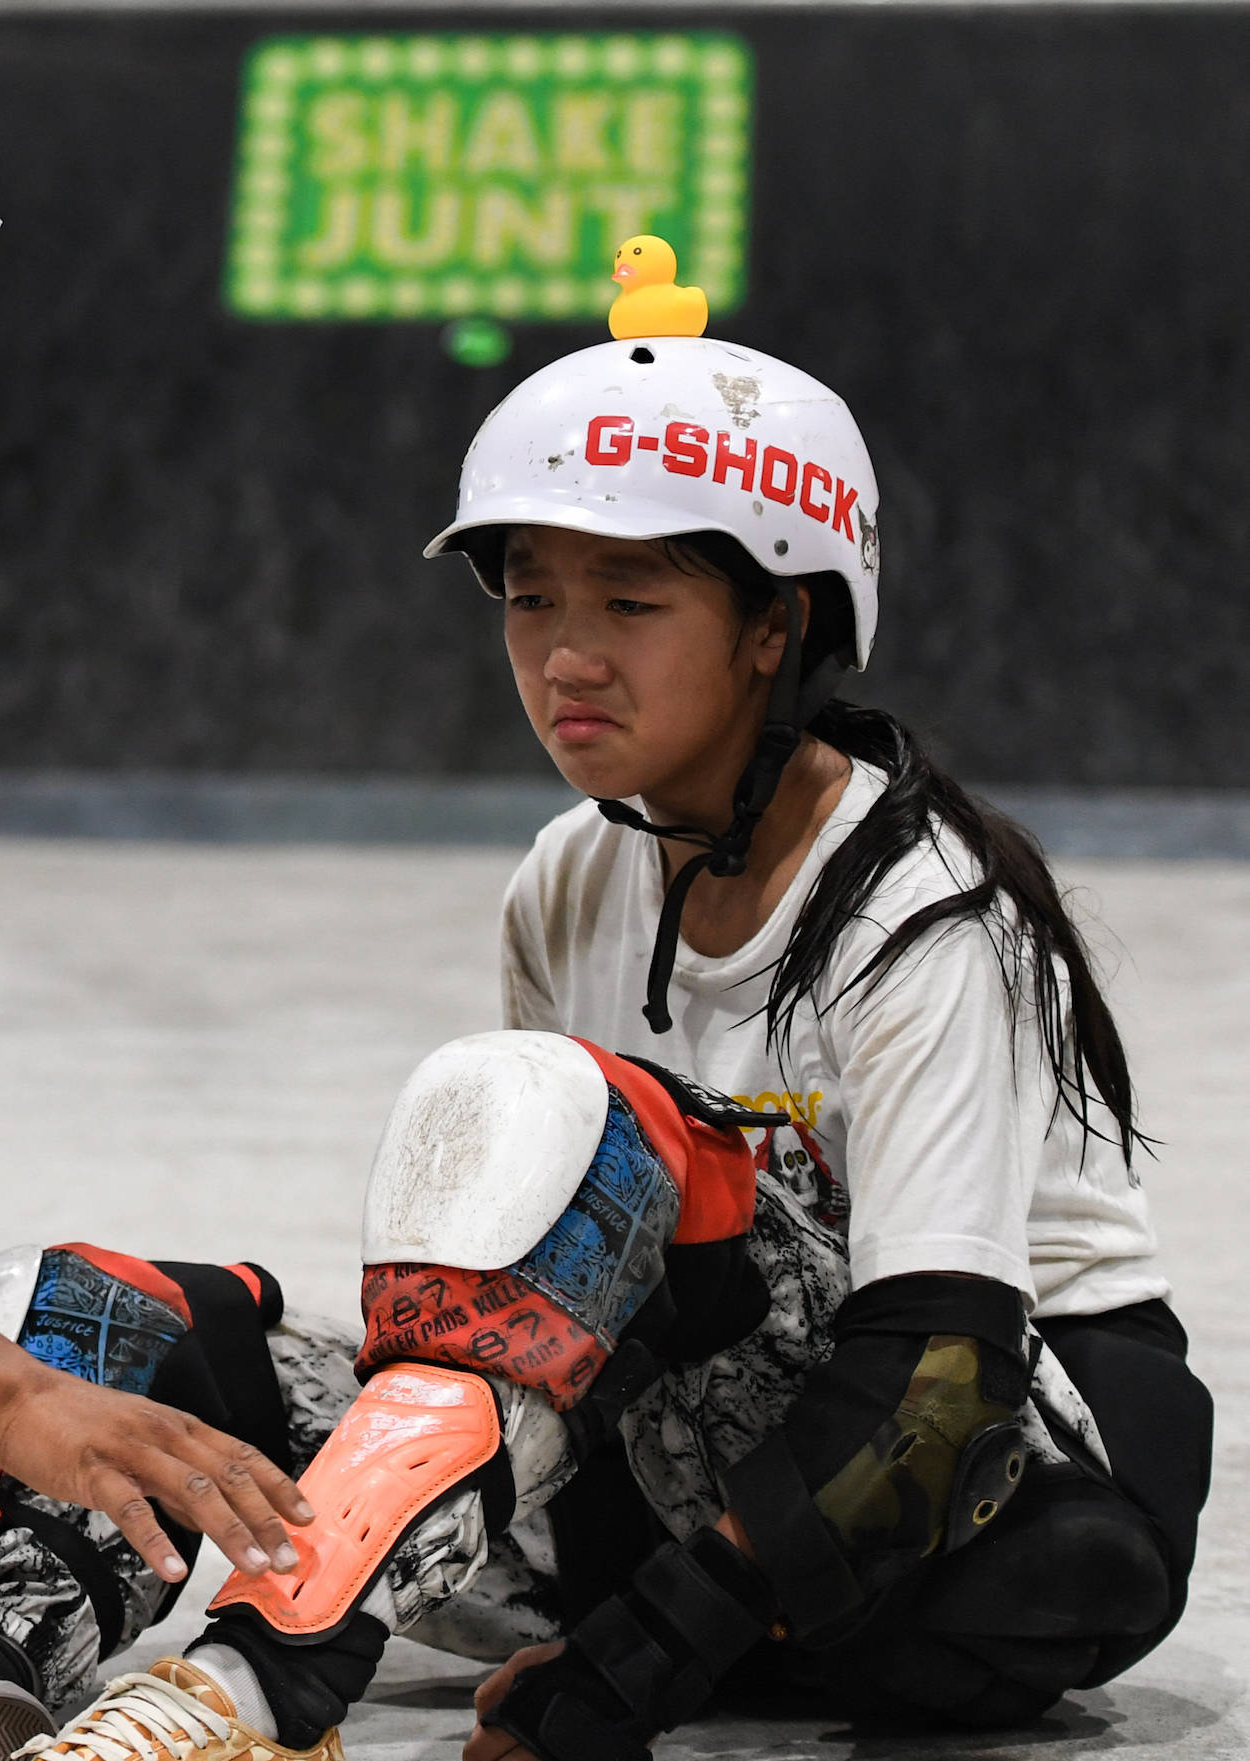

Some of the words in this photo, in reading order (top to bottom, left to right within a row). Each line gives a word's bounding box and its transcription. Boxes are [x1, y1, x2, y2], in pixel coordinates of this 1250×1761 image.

[308, 88, 683, 176] SHAKE
[300, 181, 674, 272] JUNT
[585, 415, 859, 544] G-SHOCK
[576, 1184, 630, 1233] JUSTICE
[36, 1313, 95, 1337] JUSTICE
[421, 1305, 470, 1343] PADS
